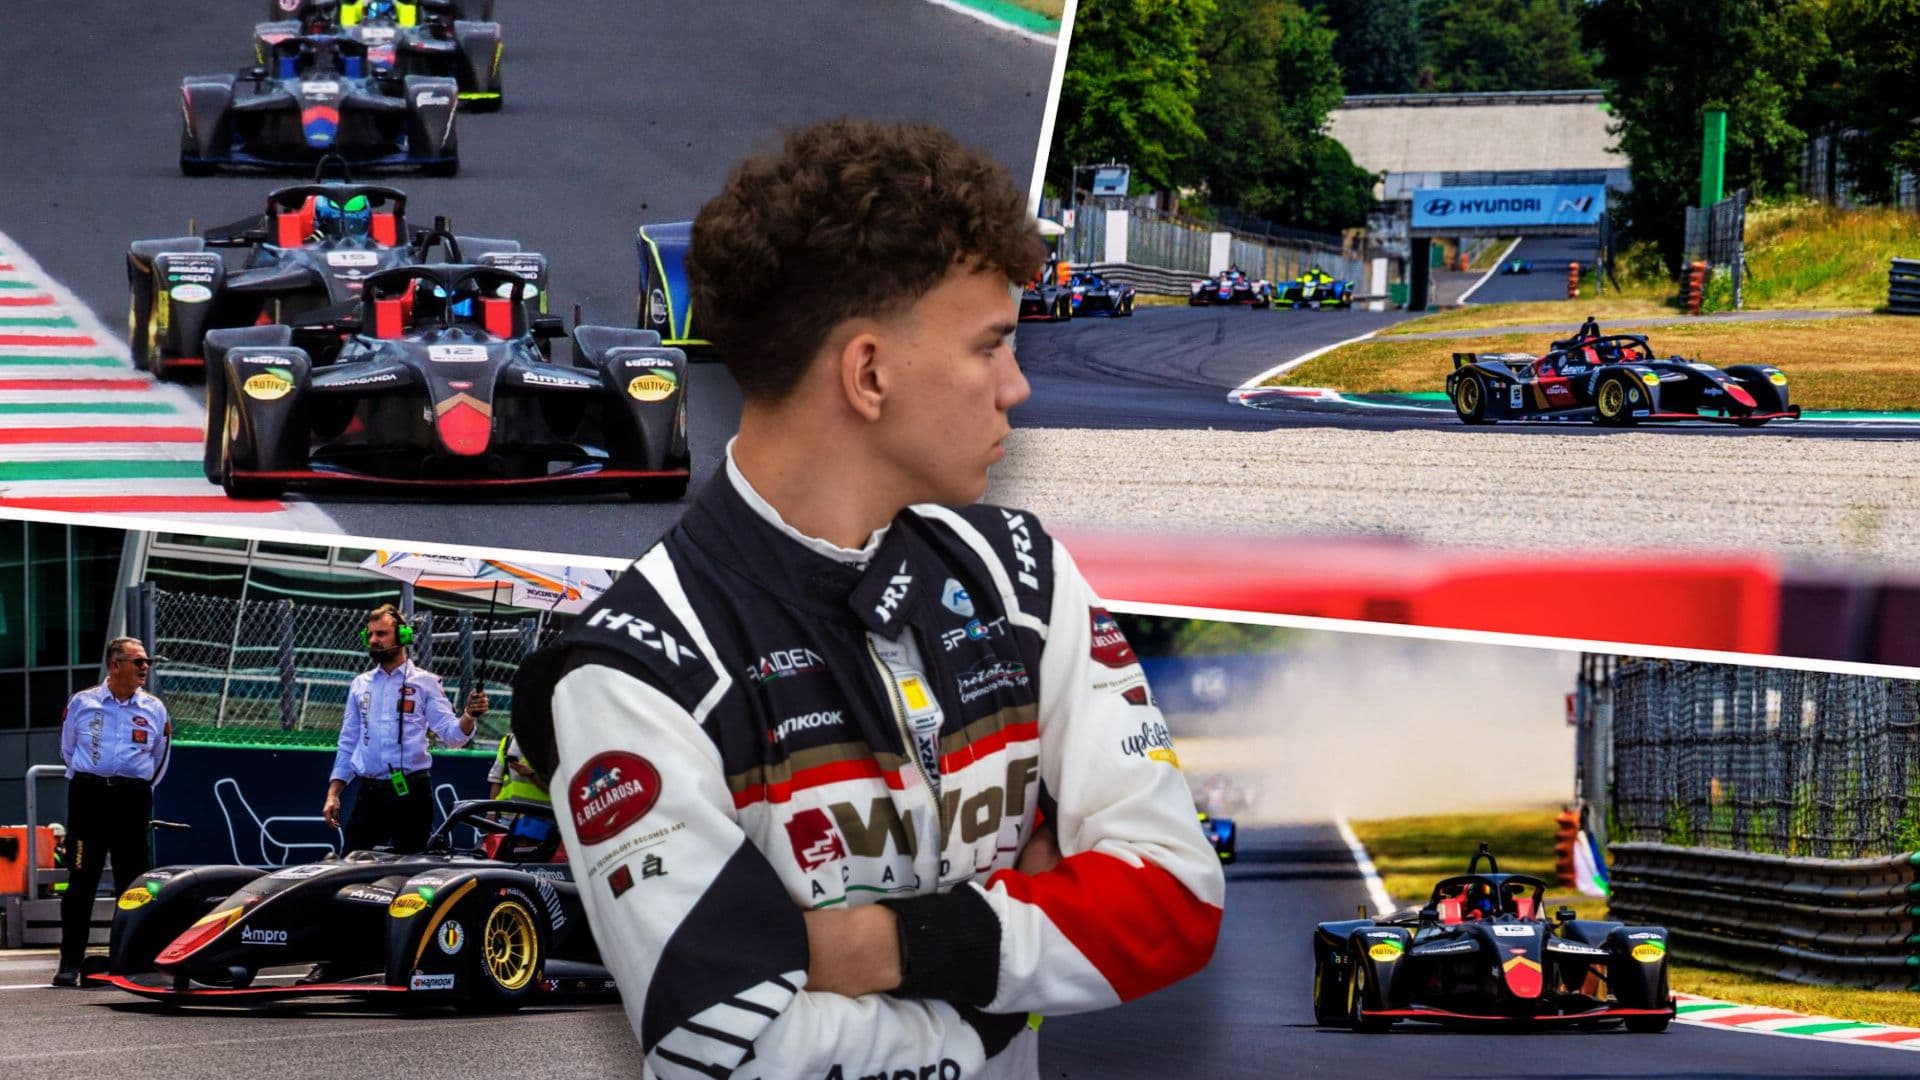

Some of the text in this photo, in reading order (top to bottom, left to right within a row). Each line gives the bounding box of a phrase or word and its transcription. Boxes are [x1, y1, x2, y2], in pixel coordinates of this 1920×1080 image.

[1459, 198, 1542, 213] HYUNDAI
[444, 347, 474, 355] 12
[522, 371, 590, 386] Ampro
[1001, 508, 1039, 591] HRX
[875, 559, 913, 624] HRX
[586, 608, 699, 666] HRX
[597, 842, 632, 868] TECHNOLOGY
[633, 827, 670, 844] BECOMES
[671, 821, 687, 832] ART
[241, 925, 288, 943] Ampro
